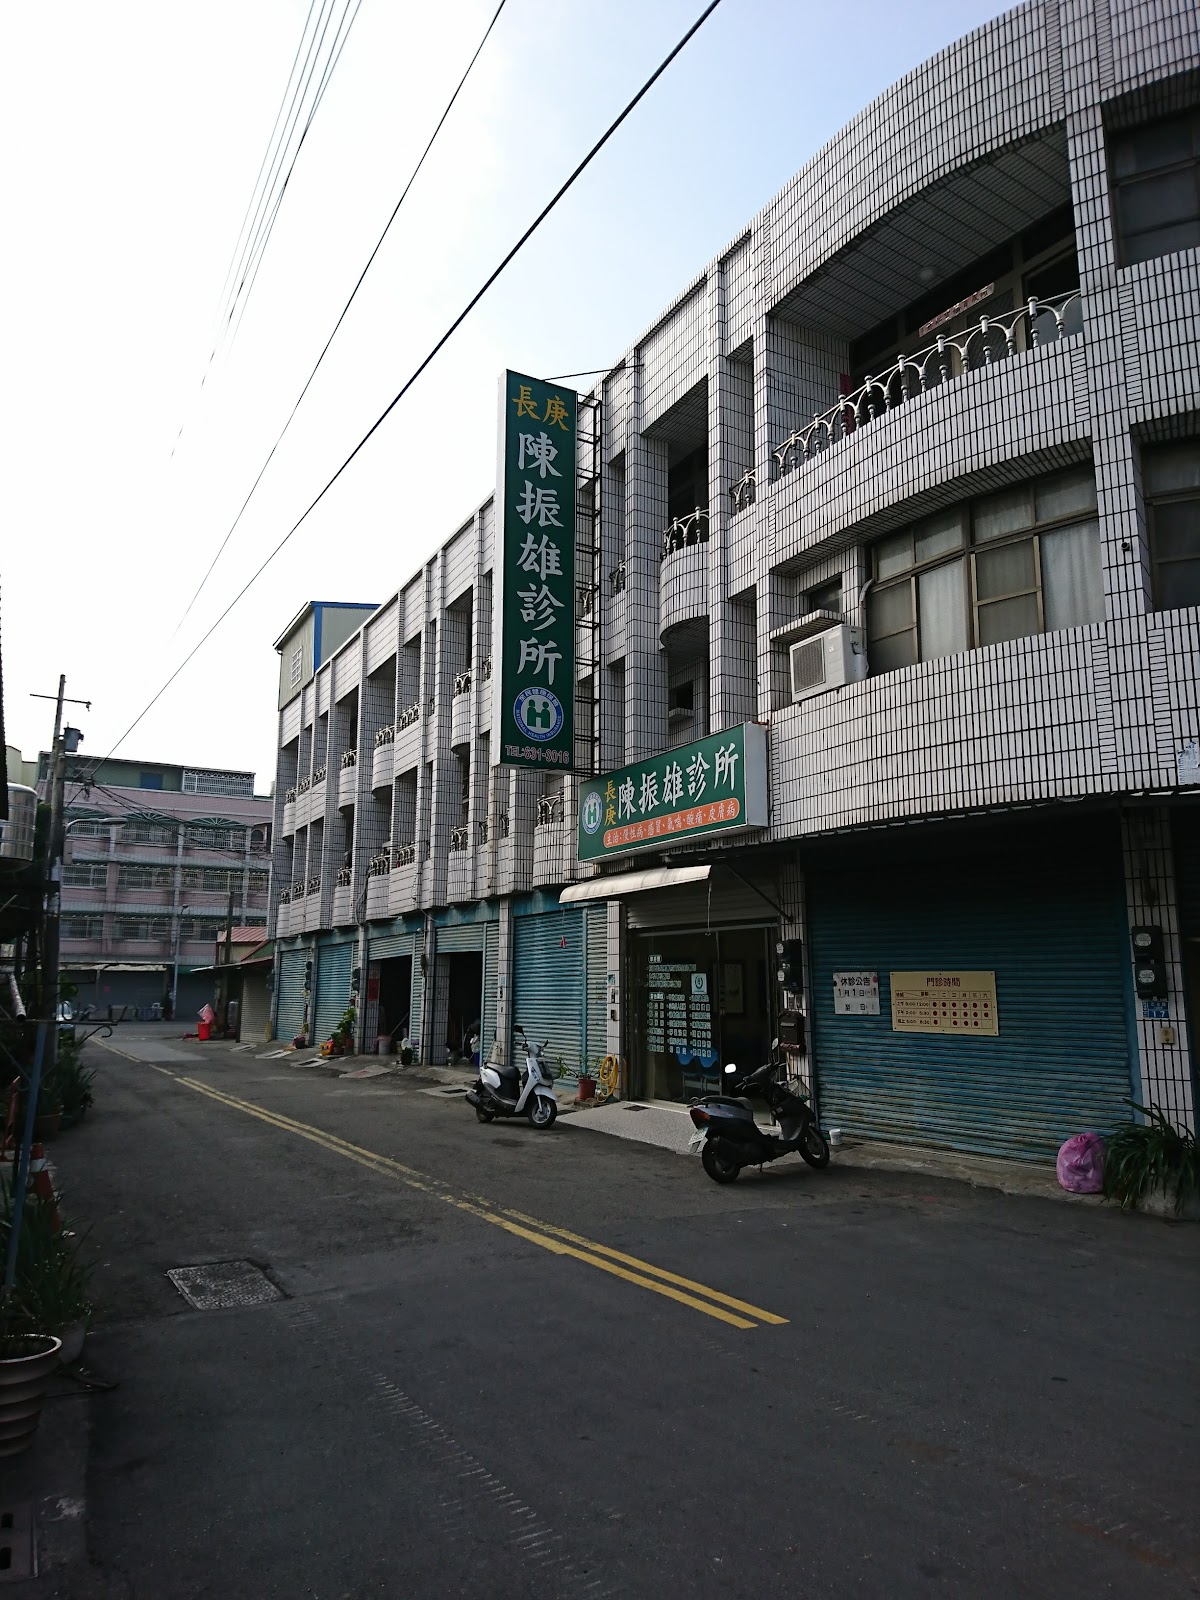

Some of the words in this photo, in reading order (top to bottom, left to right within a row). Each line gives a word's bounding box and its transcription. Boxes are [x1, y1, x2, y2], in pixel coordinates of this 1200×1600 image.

[512, 385, 570, 431] 長庚
[515, 431, 566, 686] 陳振雄診所
[528, 731, 546, 739] HEALTH
[546, 716, 561, 738] INSURANCE
[604, 780, 617, 827] 長庚
[617, 742, 739, 820] 陳振雄診所
[840, 976, 871, 986] 休診公告
[926, 977, 961, 987] 門診時間
